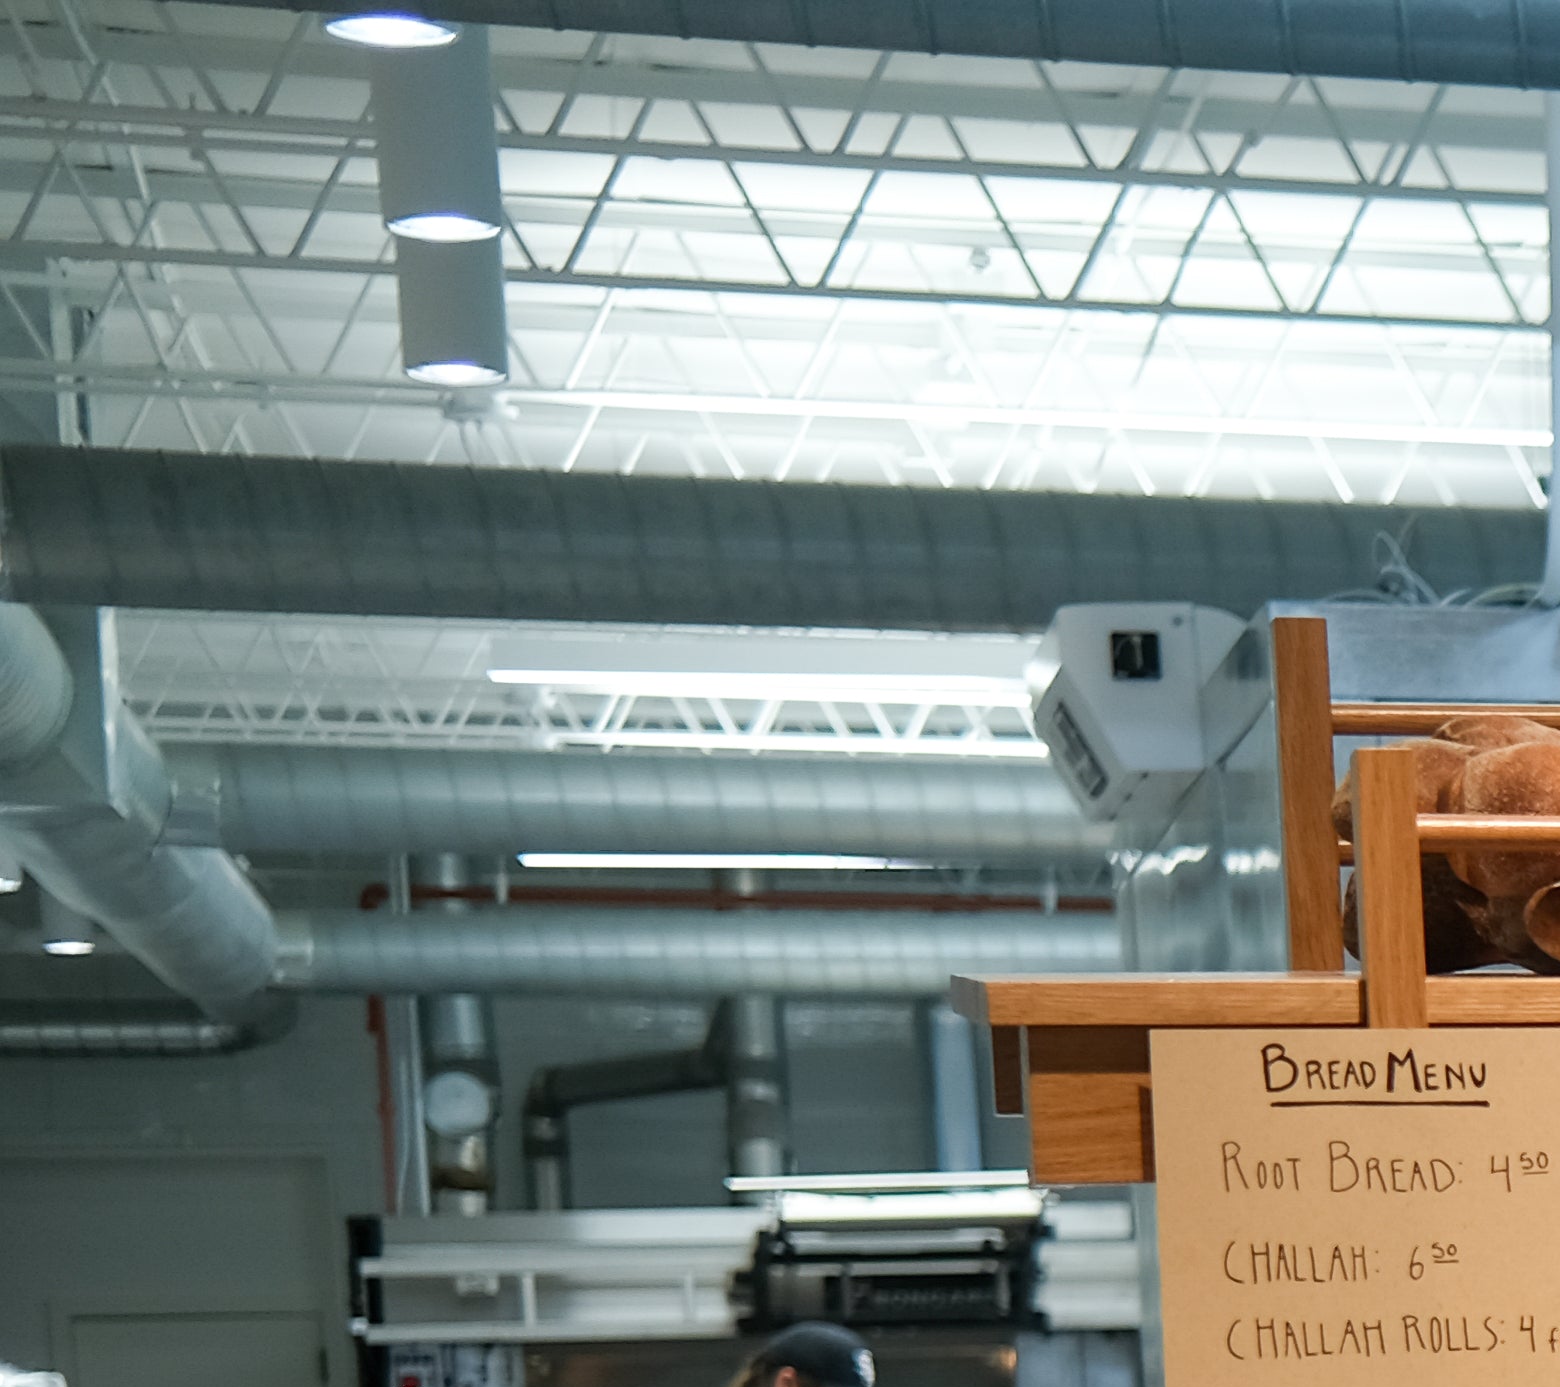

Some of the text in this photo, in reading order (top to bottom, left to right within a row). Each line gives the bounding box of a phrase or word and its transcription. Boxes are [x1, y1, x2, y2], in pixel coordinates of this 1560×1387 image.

[1260, 1042, 1487, 1094] BREAD MENU
[1220, 1140, 1302, 1193] ROOT
[1327, 1139, 1463, 1195] BREAD:
[1223, 1240, 1380, 1285] CHALLAH:
[1226, 1317, 1387, 1361] CHALLAH
[1400, 1313, 1506, 1354] ROLLS:
[1519, 1314, 1536, 1353] 4
